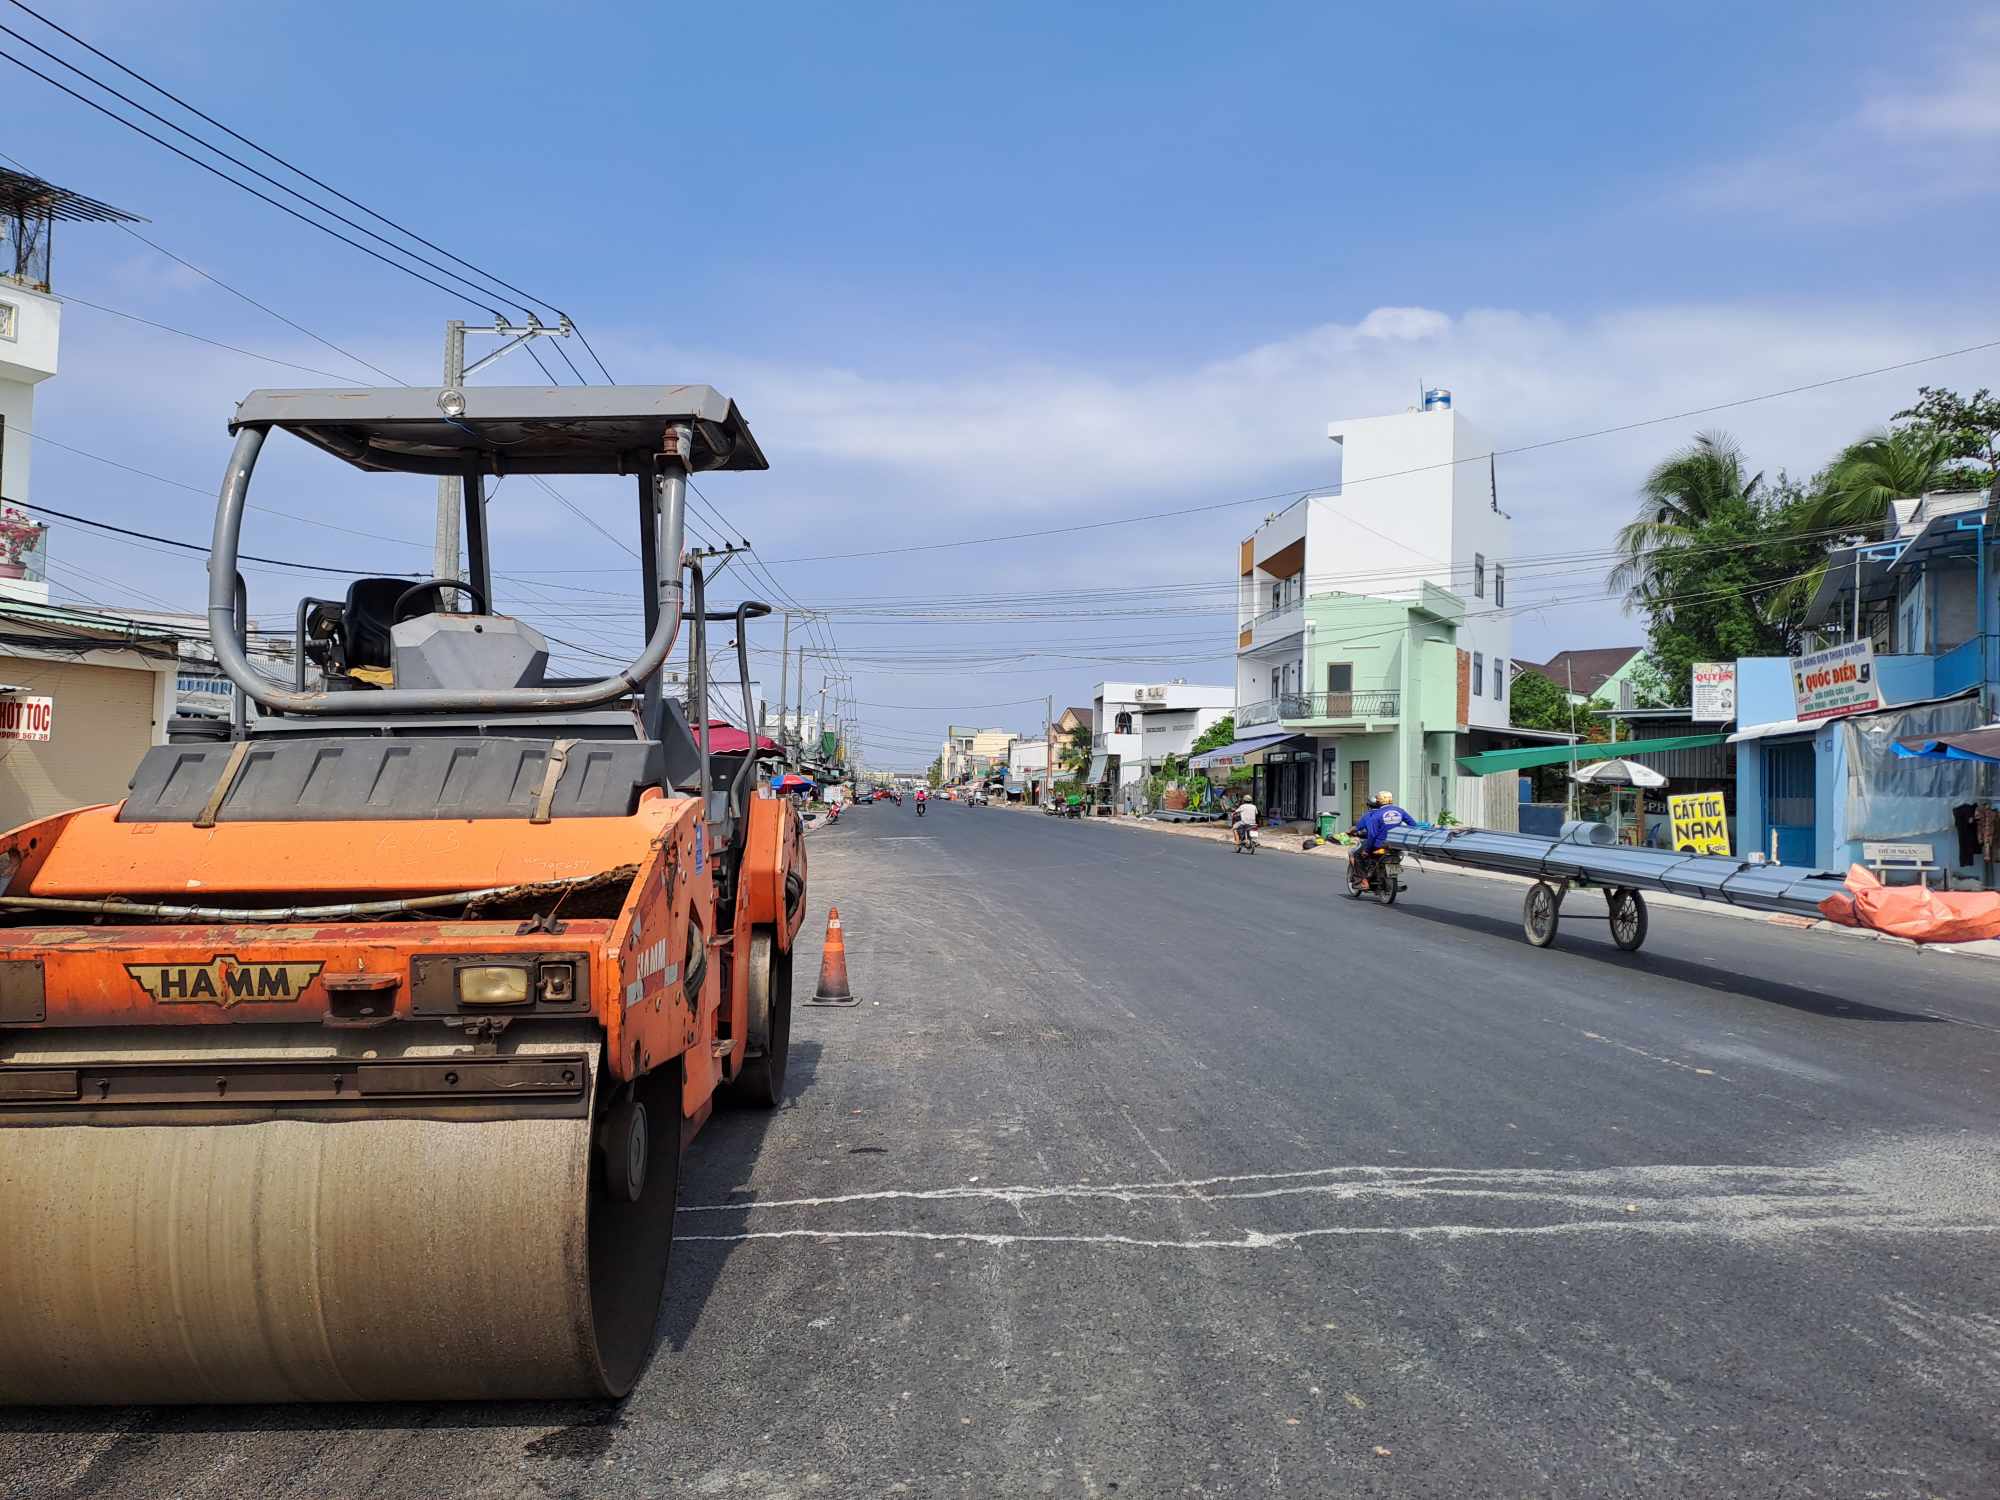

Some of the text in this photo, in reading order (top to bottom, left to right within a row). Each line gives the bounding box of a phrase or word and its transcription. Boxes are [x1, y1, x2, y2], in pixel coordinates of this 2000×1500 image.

[27, 697, 51, 731] TÓC
[1698, 796, 1721, 818] TÓC
[1675, 820, 1724, 842] NAM
[161, 967, 291, 998] HAMM
